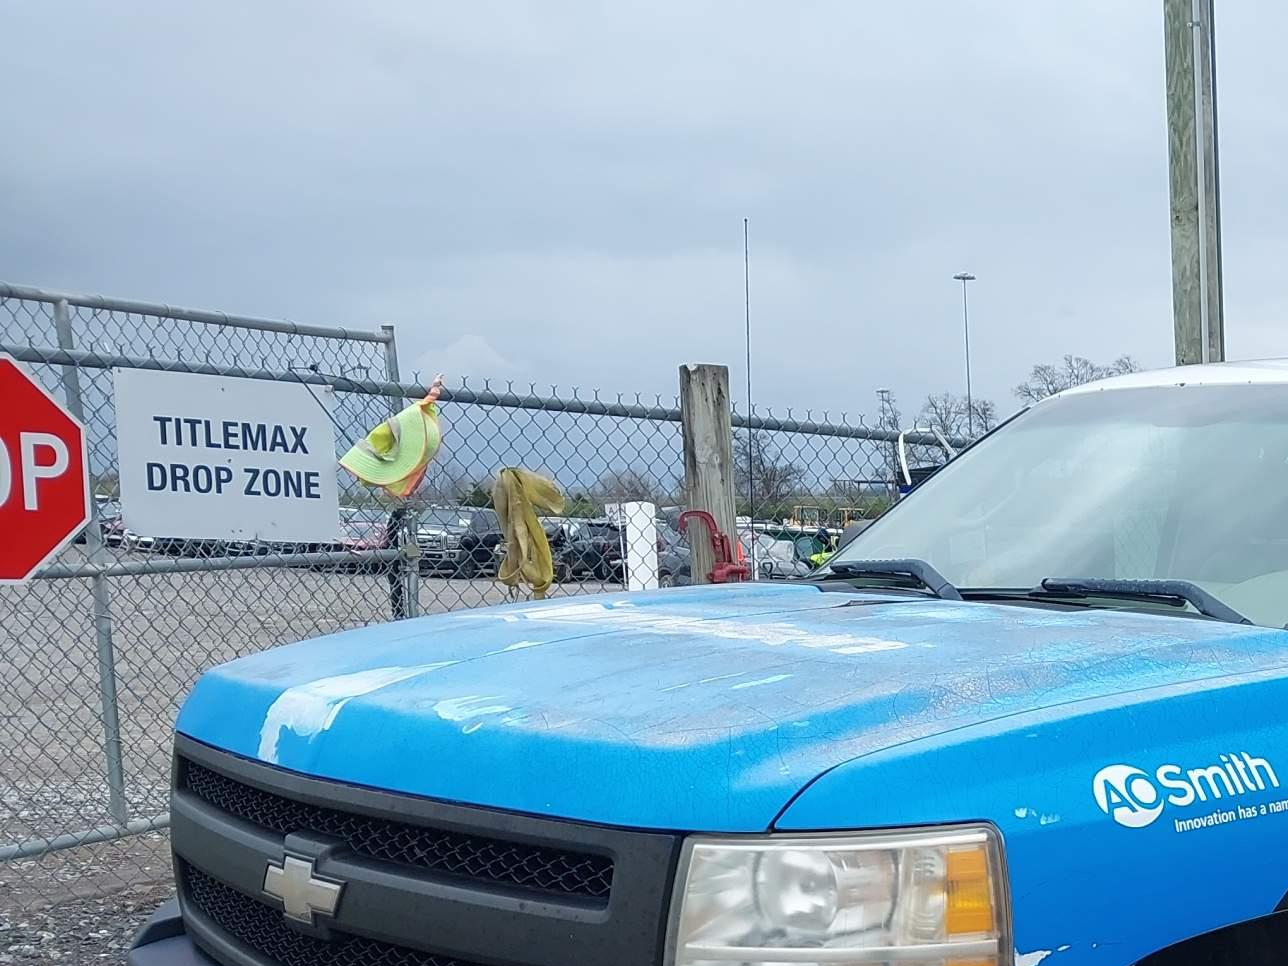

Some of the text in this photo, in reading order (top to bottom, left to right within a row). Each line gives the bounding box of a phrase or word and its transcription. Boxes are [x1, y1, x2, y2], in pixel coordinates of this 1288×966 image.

[153, 415, 309, 454] TITLEMAX
[0, 432, 70, 511] P
[146, 462, 321, 499] DROP ZONE
[1156, 752, 1279, 806] Smith
[1174, 809, 1236, 833] Innovation
[1239, 803, 1257, 820] has
[1259, 807, 1267, 816] a
